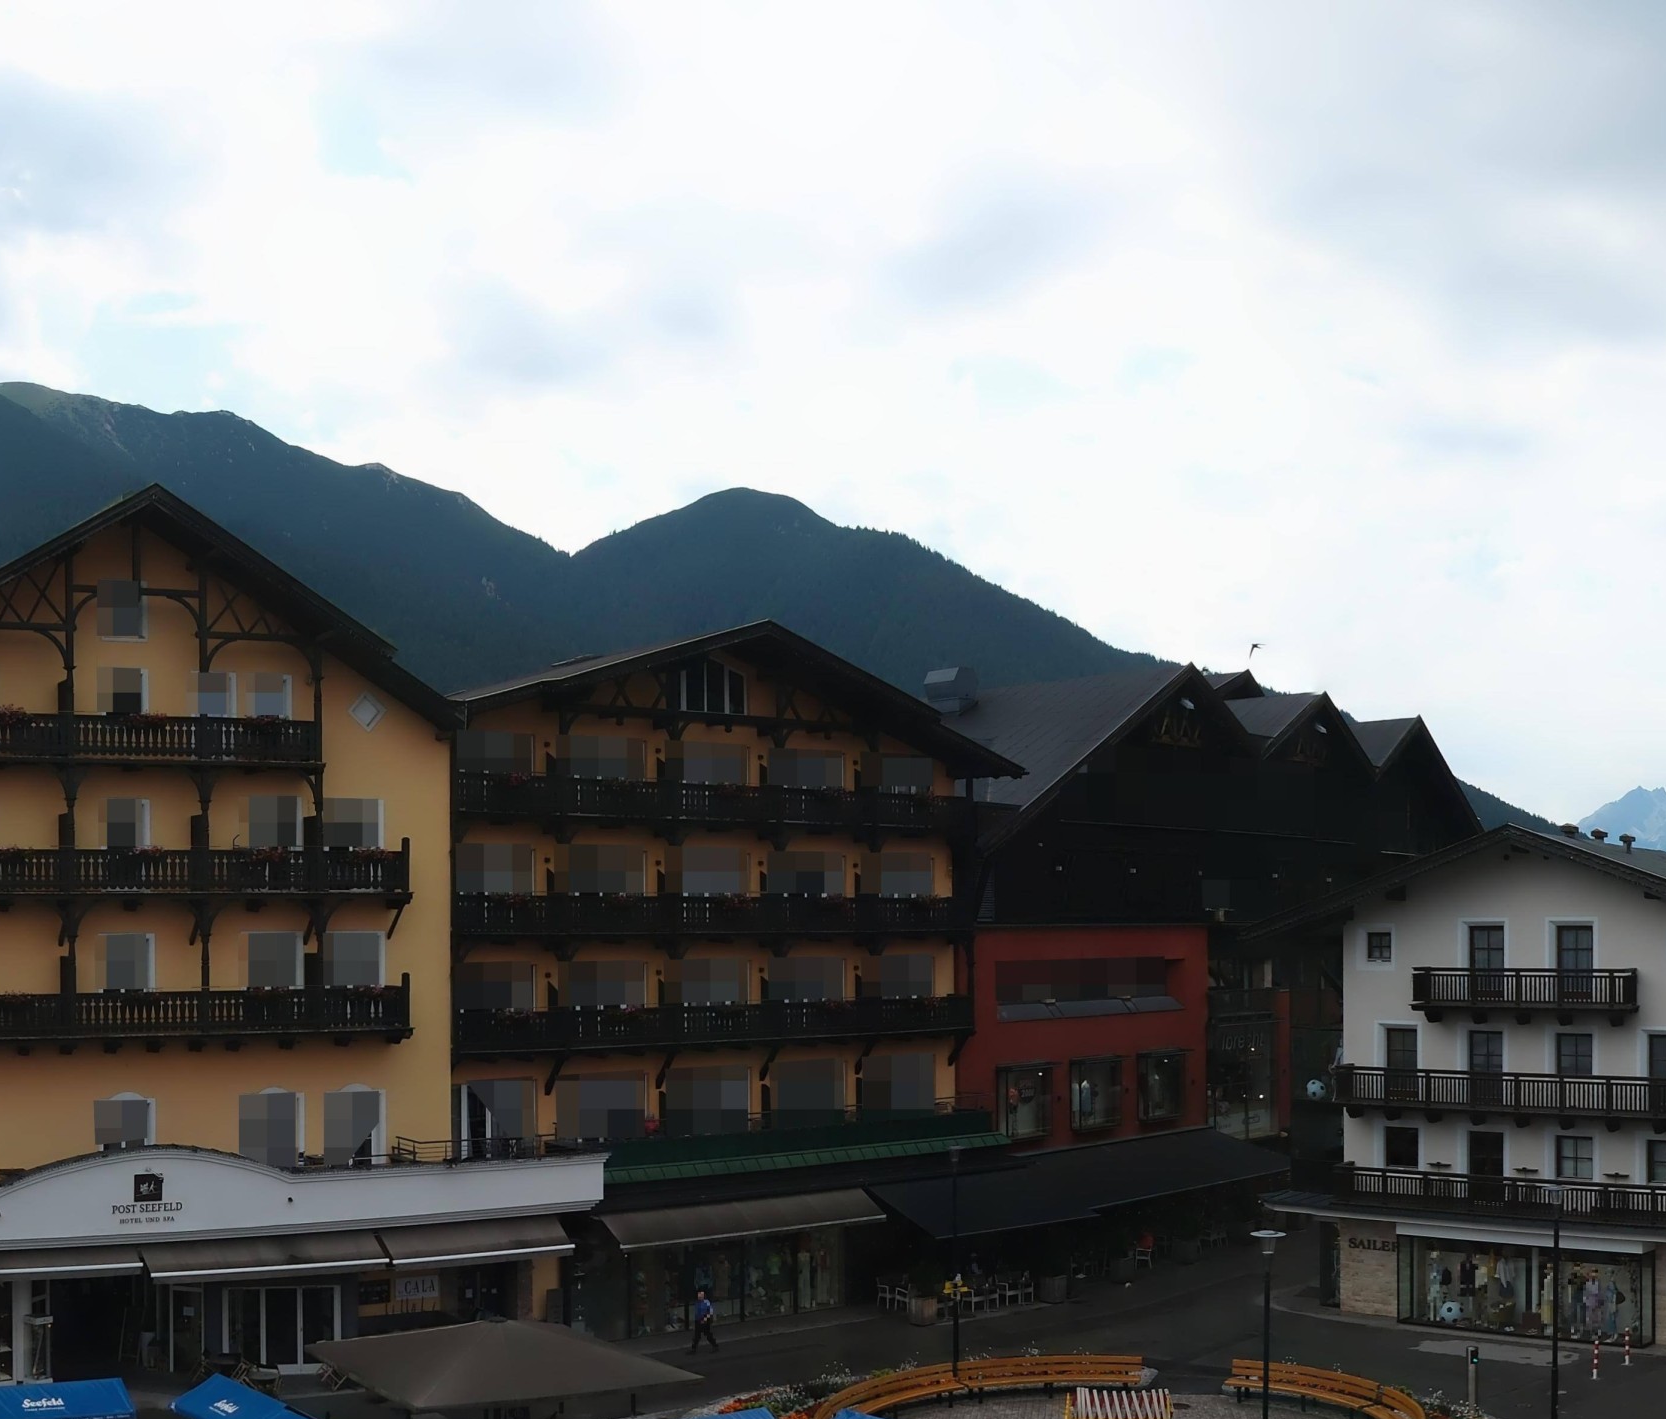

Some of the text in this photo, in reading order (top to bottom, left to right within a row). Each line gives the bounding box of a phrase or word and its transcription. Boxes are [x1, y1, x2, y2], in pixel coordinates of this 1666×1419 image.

[112, 1202, 182, 1215] POST SEEFELD
[22, 1398, 64, 1408] Seefeld
